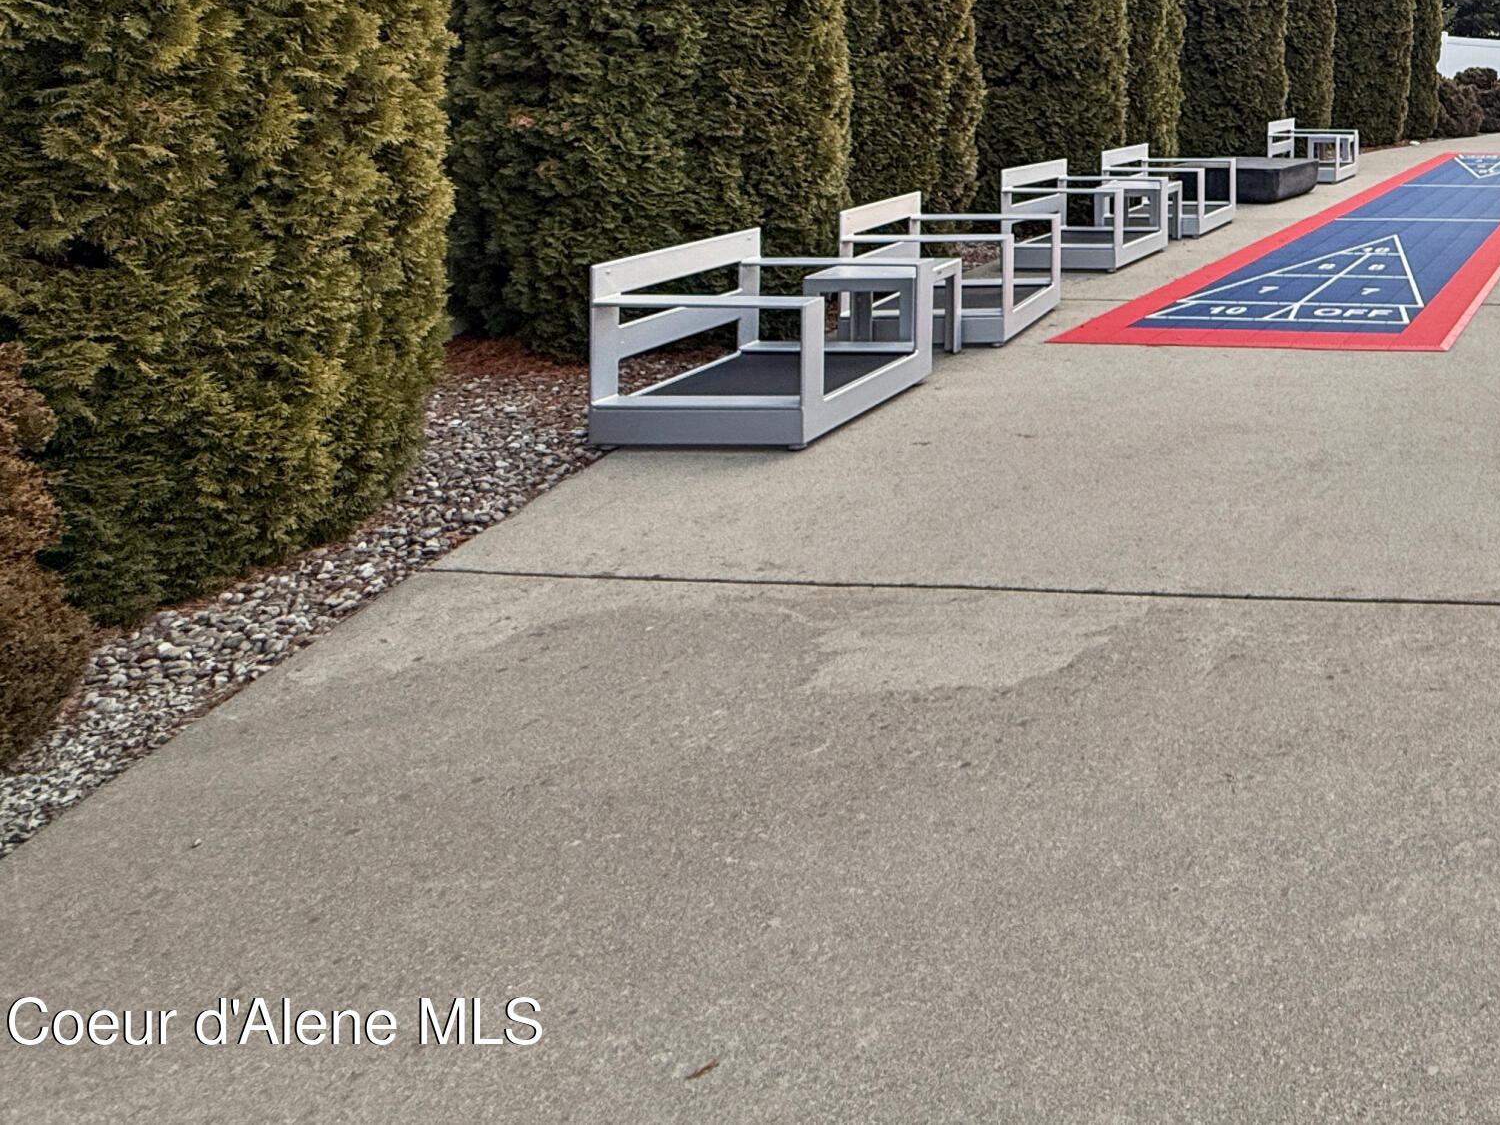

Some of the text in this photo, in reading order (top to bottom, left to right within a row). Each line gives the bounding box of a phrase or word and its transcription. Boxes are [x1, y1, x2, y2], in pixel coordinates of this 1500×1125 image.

[1258, 285, 1280, 294] 7
[1360, 287, 1381, 295] 7
[1209, 305, 1248, 315] 10
[1313, 307, 1393, 318] OFF
